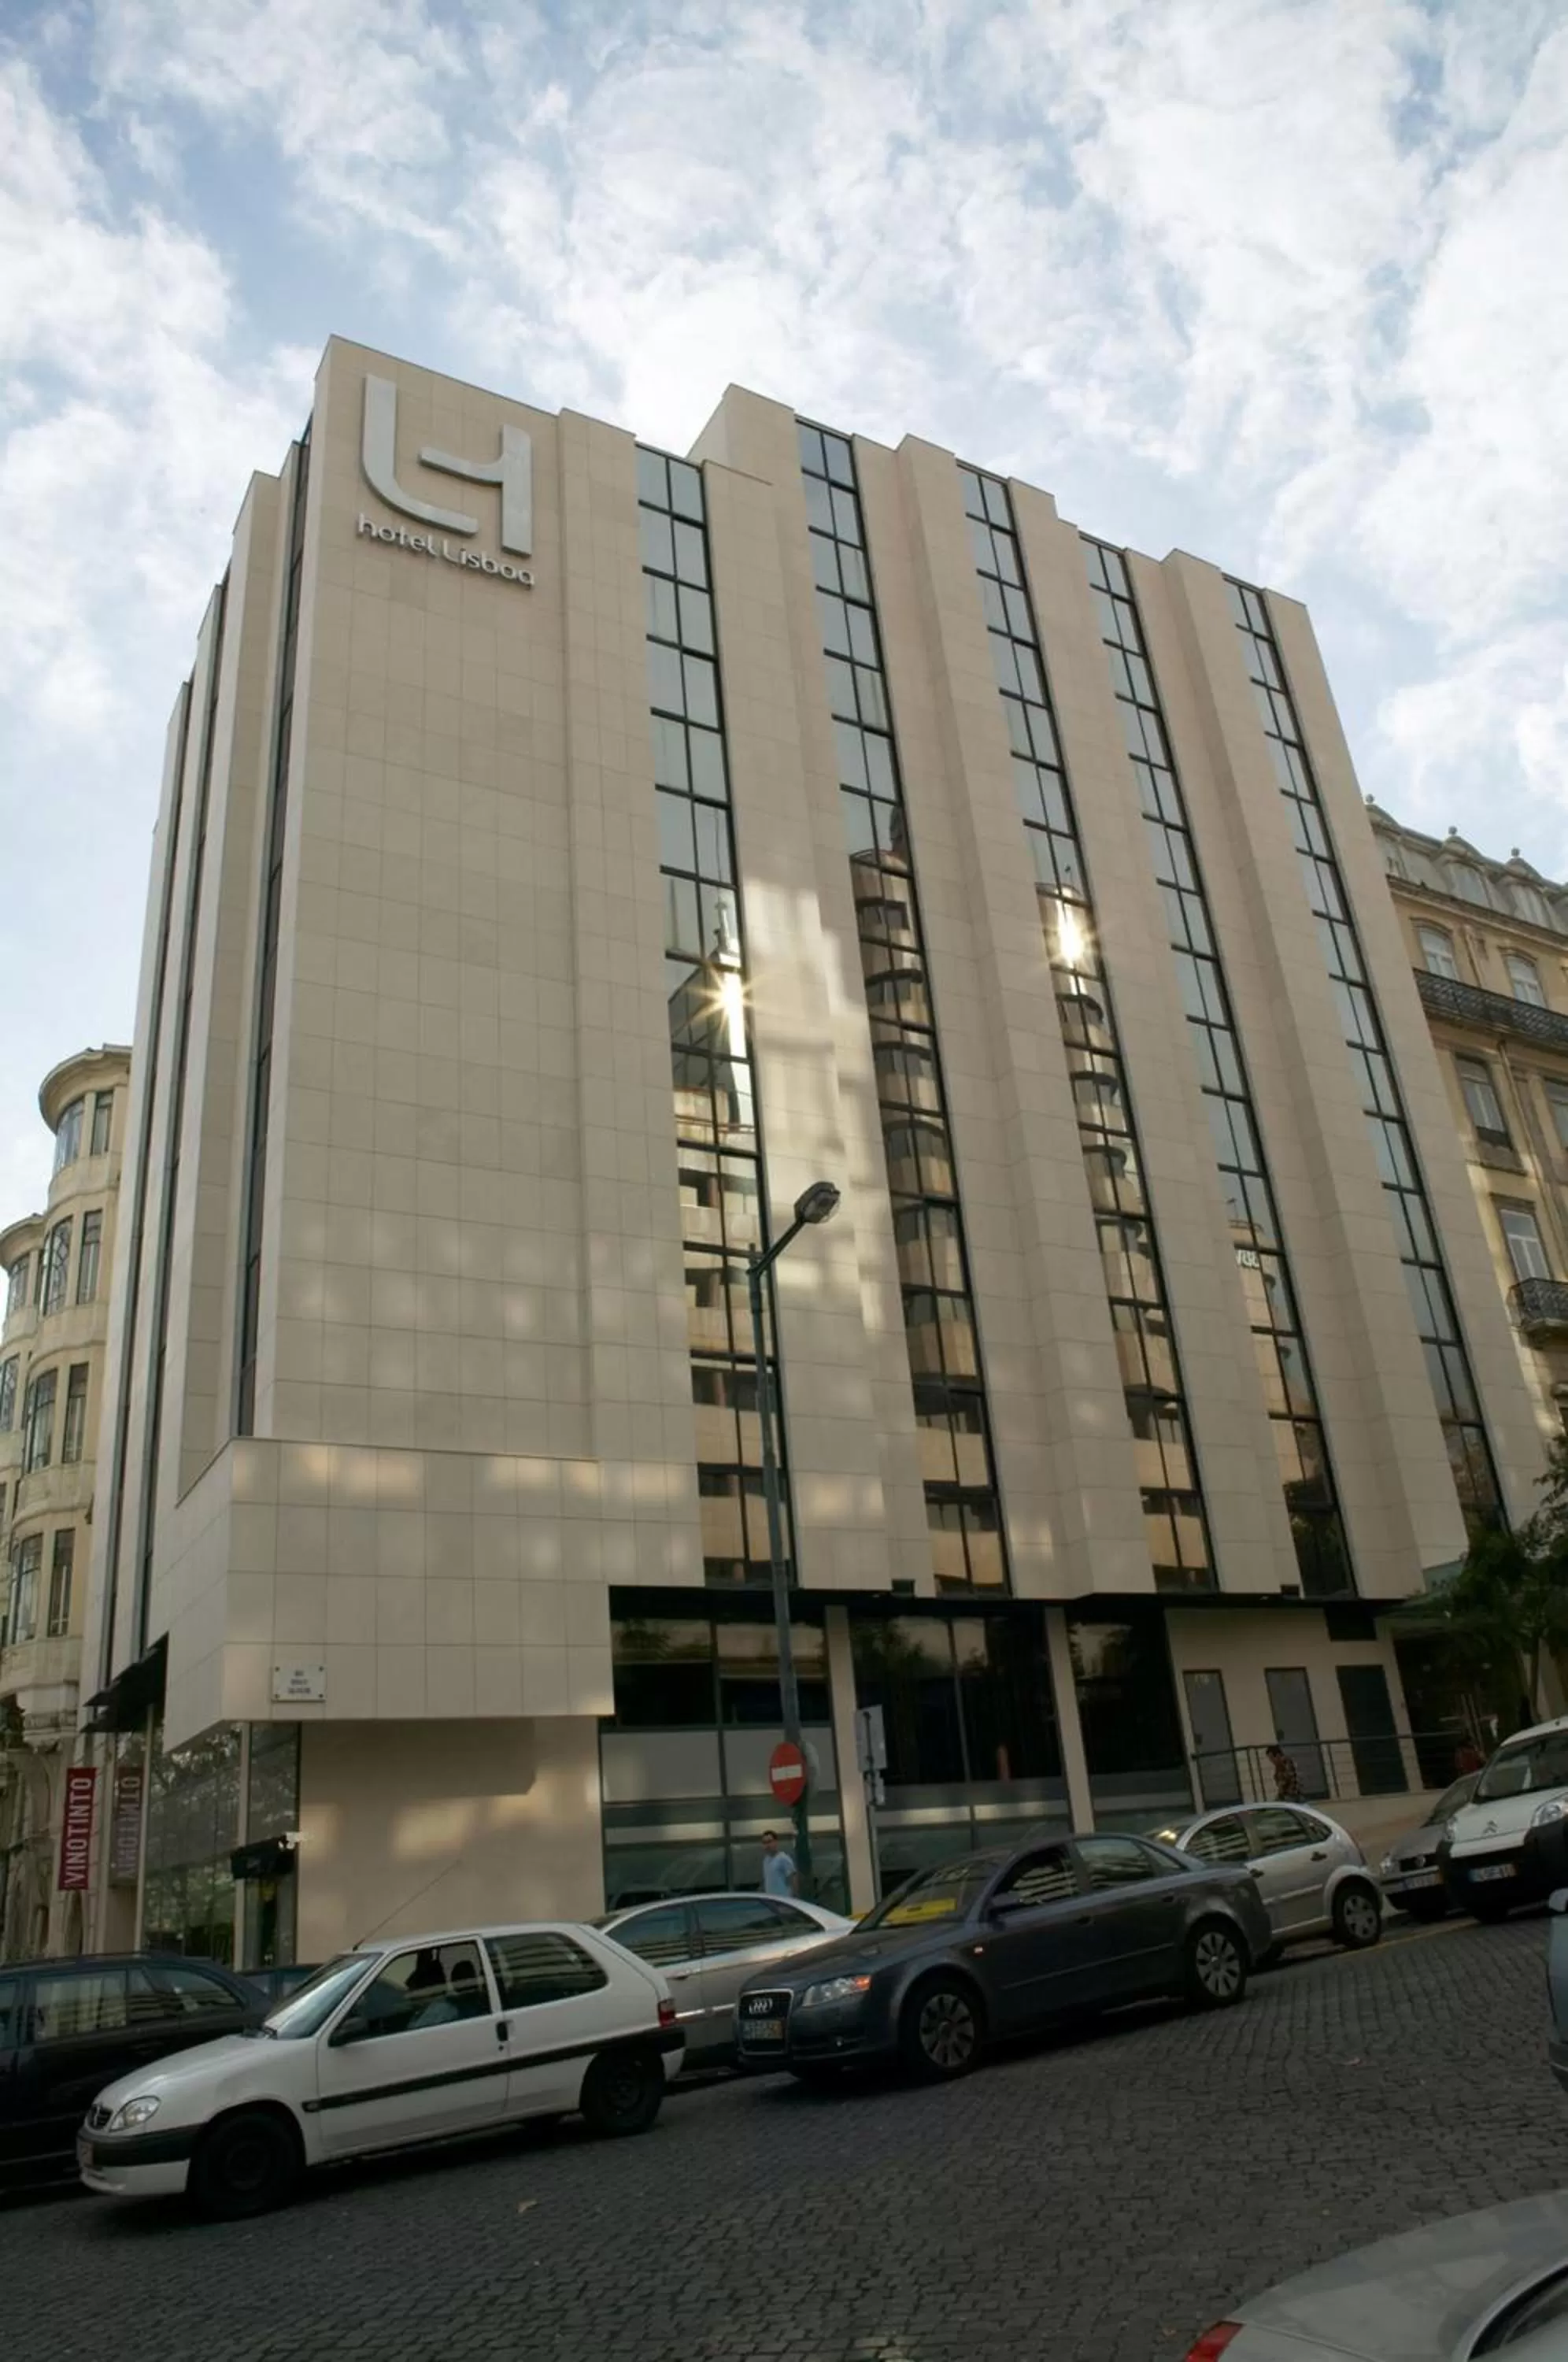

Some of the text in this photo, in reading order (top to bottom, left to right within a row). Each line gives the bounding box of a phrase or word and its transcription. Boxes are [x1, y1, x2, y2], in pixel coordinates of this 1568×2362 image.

[357, 513, 536, 587] hotel Lisboa
[64, 1777, 92, 1884] VINOTINTO
